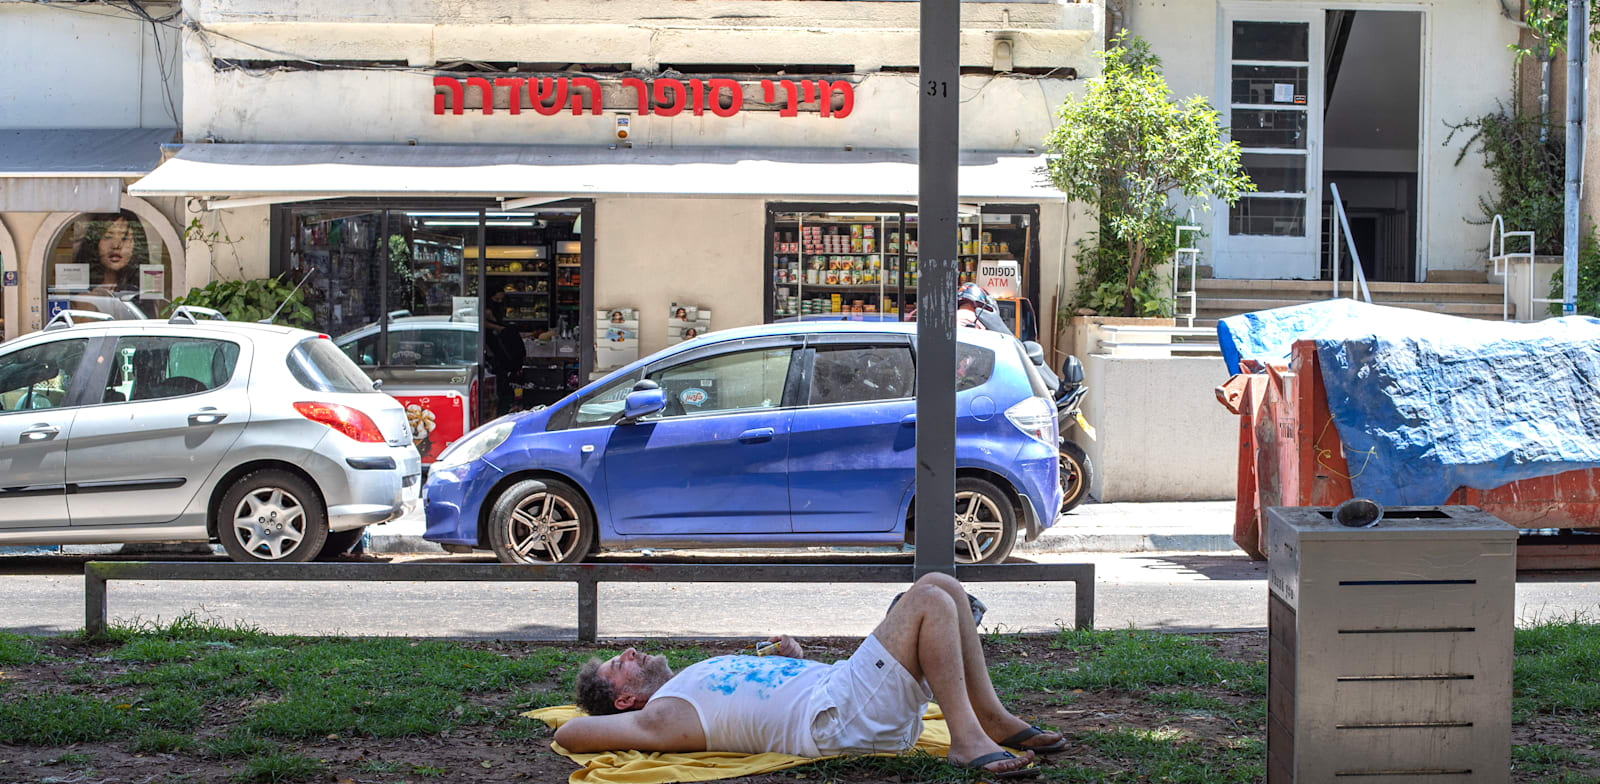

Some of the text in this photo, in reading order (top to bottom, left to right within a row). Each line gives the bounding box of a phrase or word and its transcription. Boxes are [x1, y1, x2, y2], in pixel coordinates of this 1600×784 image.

[927, 80, 947, 97] 31
[433, 77, 855, 118] מיני סופר השדרה
[982, 267, 1015, 277] כספומט
[987, 278, 1008, 287] ATM
